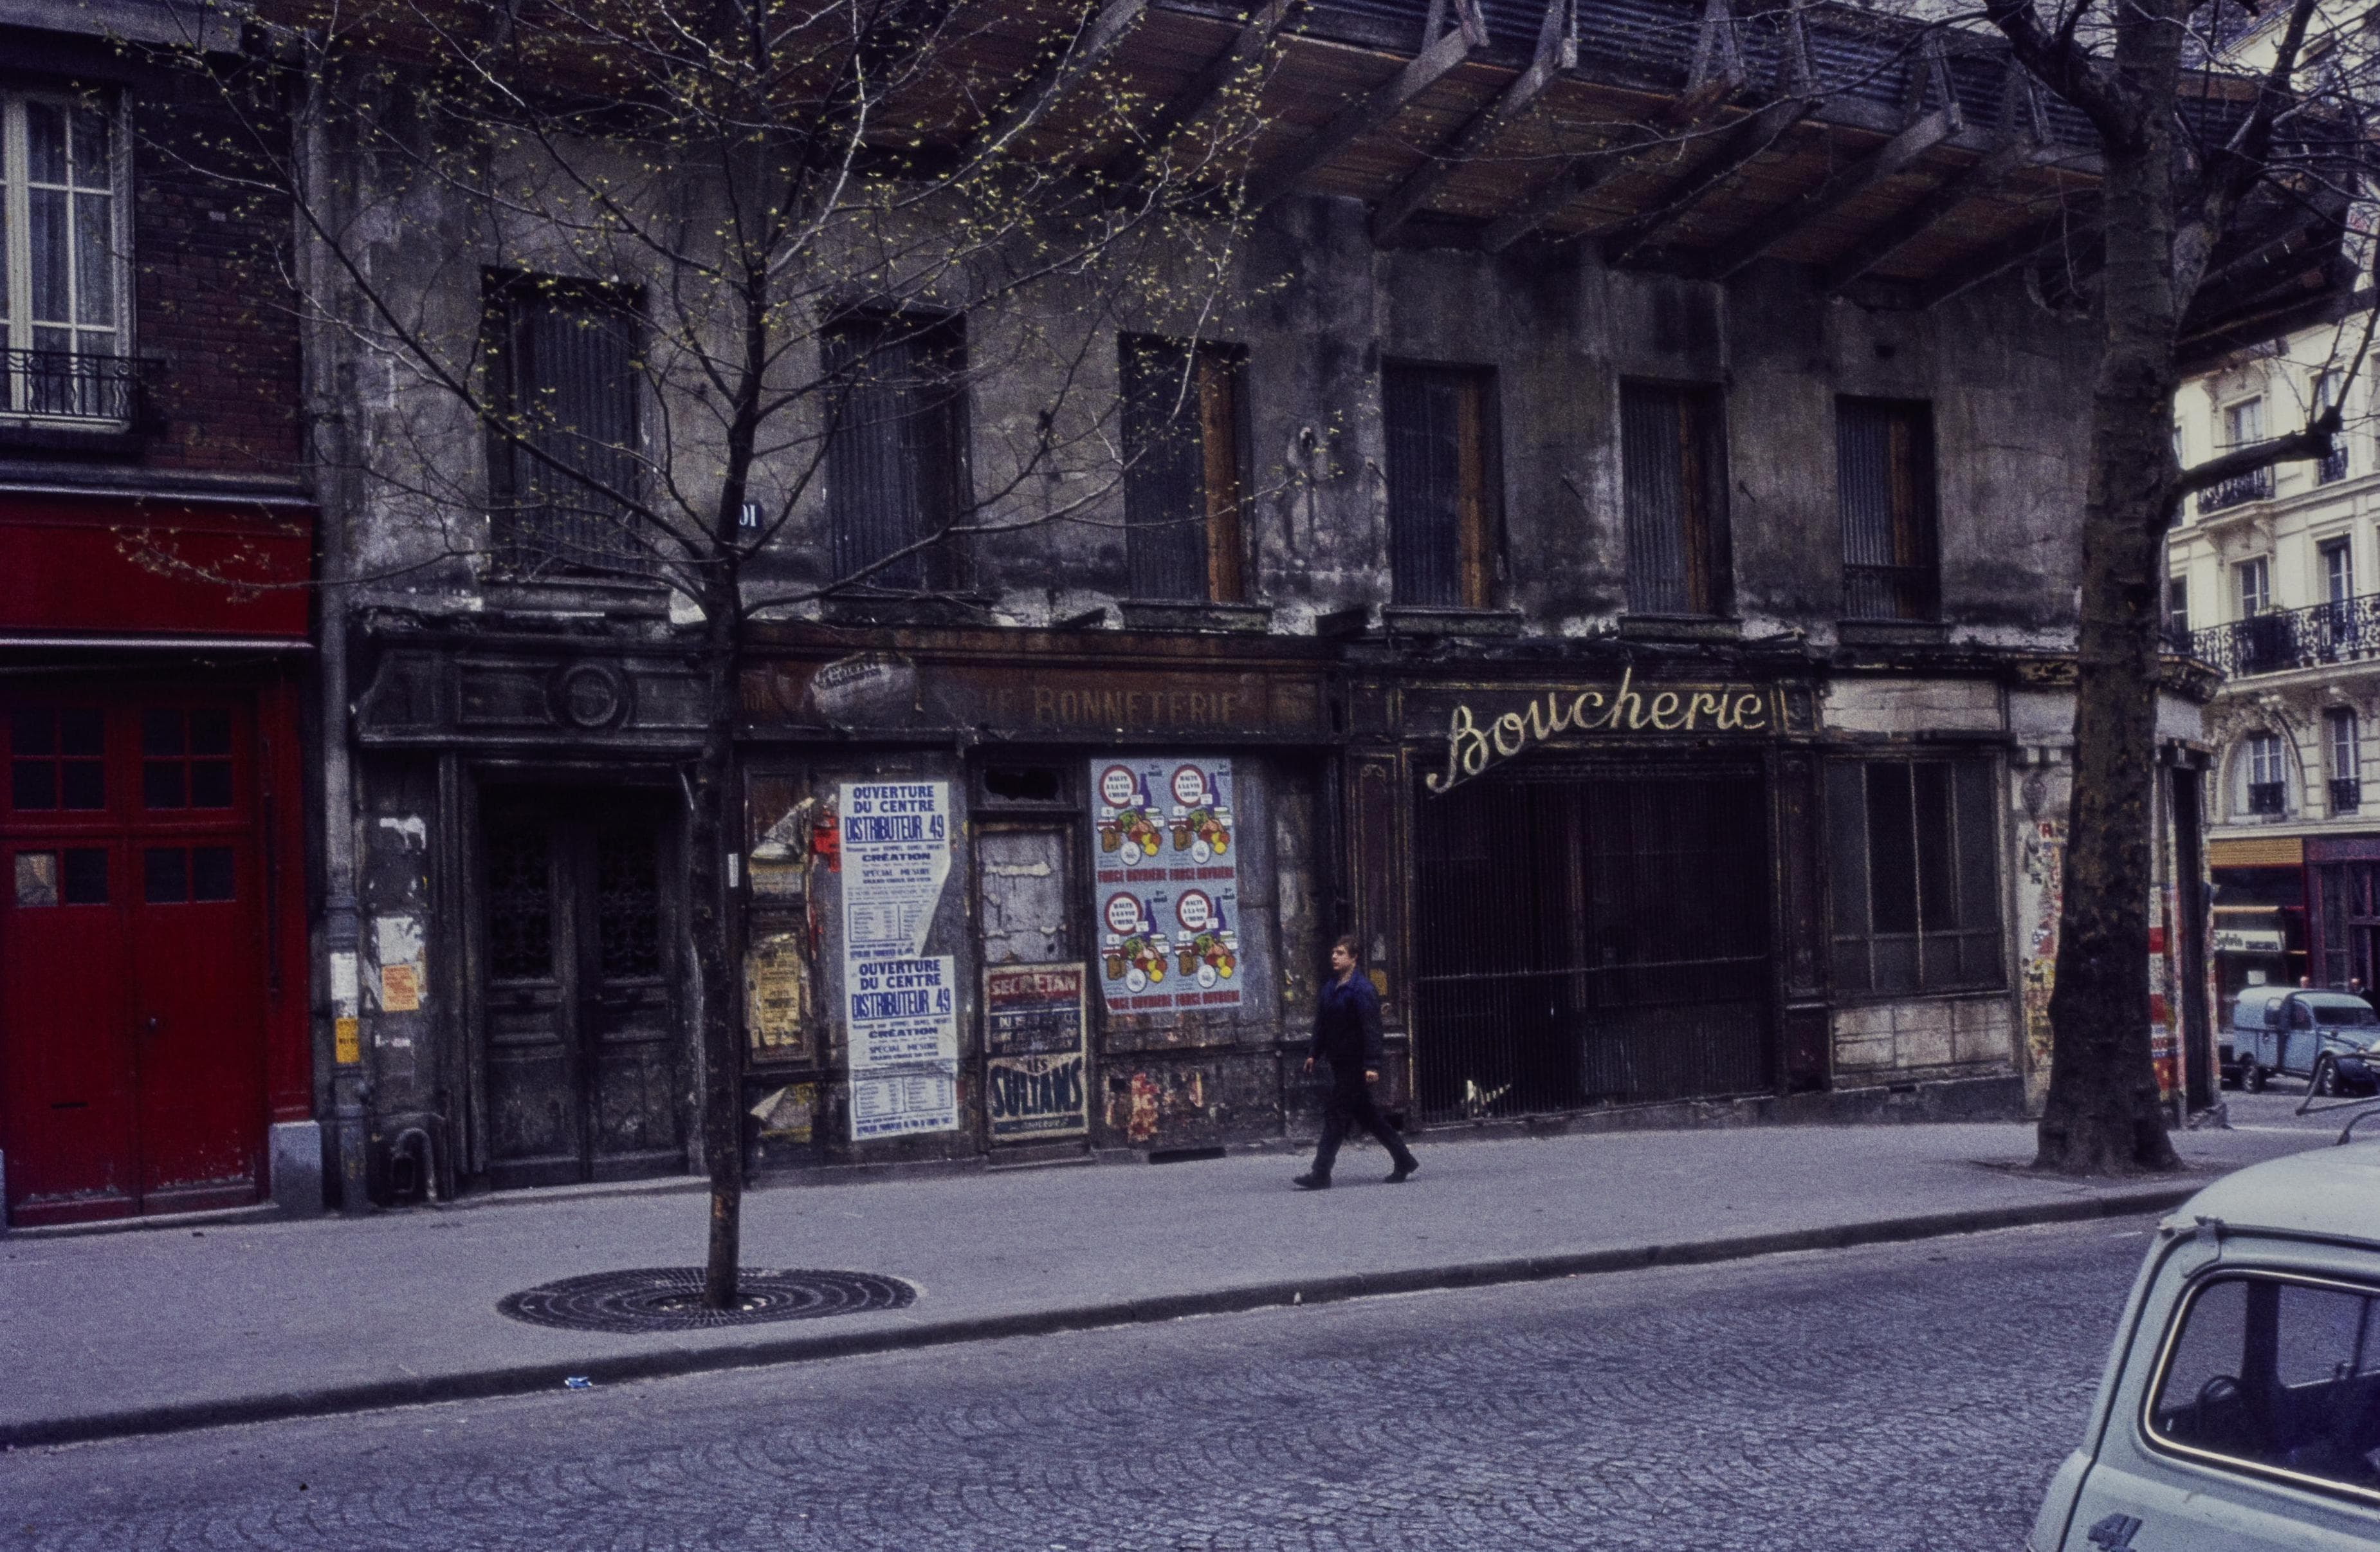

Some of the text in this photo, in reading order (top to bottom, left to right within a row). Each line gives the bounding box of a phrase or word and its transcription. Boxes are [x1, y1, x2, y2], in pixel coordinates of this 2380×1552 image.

[1034, 686, 1236, 725] BONNETERIE
[1427, 666, 1765, 793] Boucherie
[853, 786, 934, 799] OUVERTURE
[854, 799, 935, 813] DU CENTRE
[845, 814, 944, 840] DISTRIBUTEUR 49
[859, 959, 941, 975] OUVERTURE
[860, 973, 941, 990] DU CENTRE
[991, 974, 1077, 995] SECRETAN
[852, 988, 951, 1018] DISTRIBUTEUR 49
[991, 1057, 1083, 1118] SULTANS
